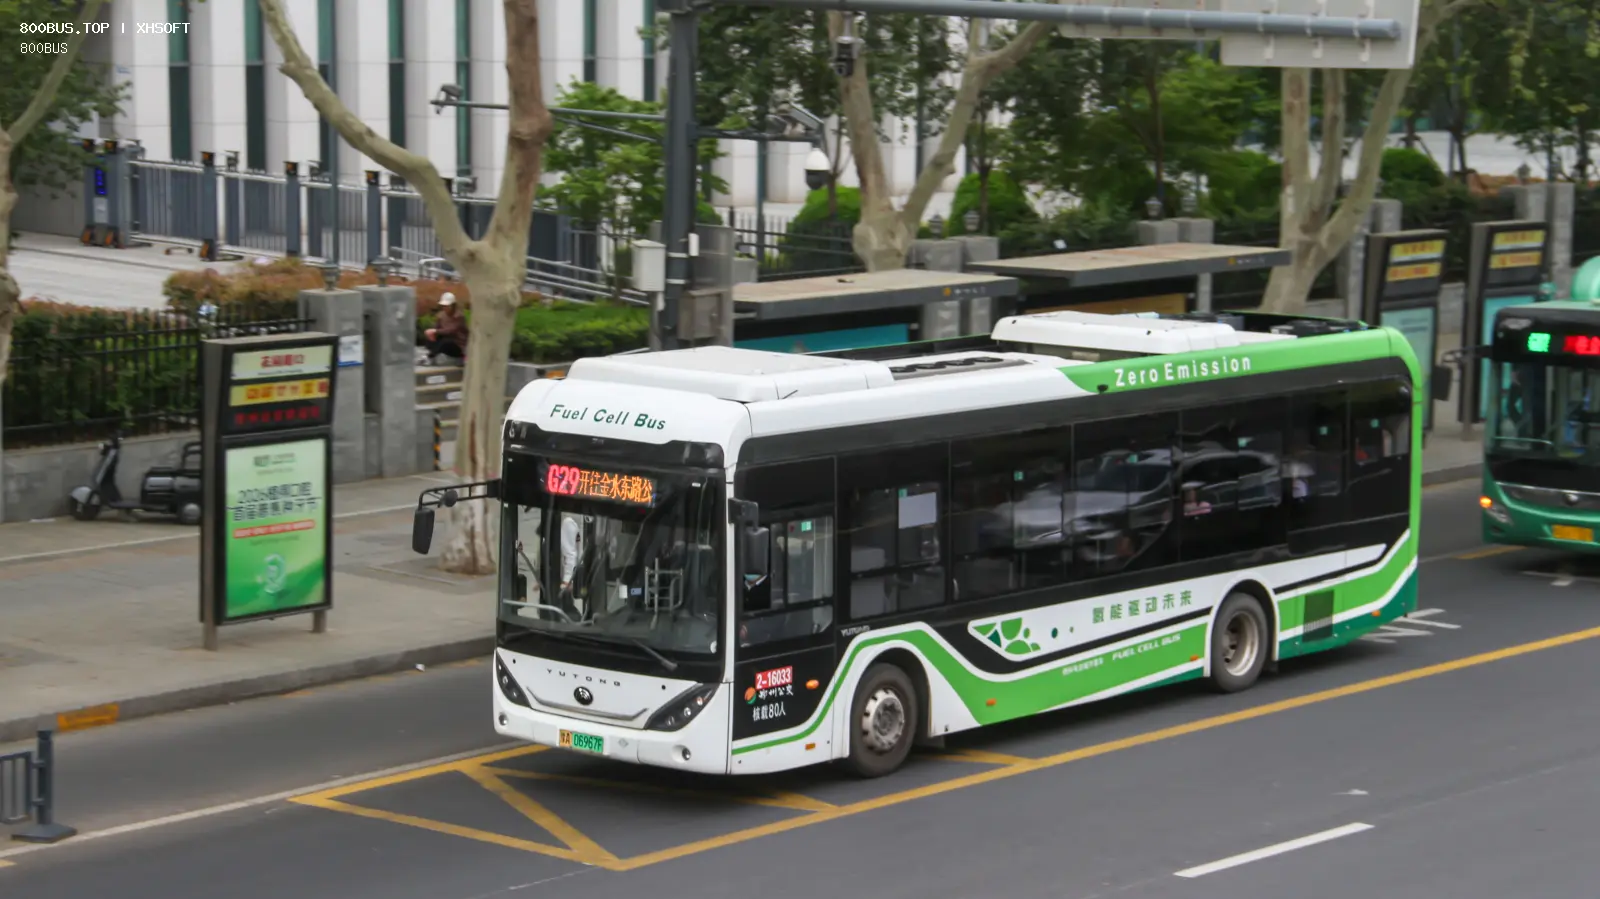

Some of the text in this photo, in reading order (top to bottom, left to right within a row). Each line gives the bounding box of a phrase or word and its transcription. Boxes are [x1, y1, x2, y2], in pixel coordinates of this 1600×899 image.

[1114, 356, 1251, 387] Zero Emission
[550, 404, 666, 430] Fuel Cell Bus
[547, 464, 581, 495] G29
[546, 668, 621, 686] YUTONG
[757, 668, 791, 689] 2-16033
[752, 701, 786, 721] 核载80人
[574, 734, 603, 751] 06967F
